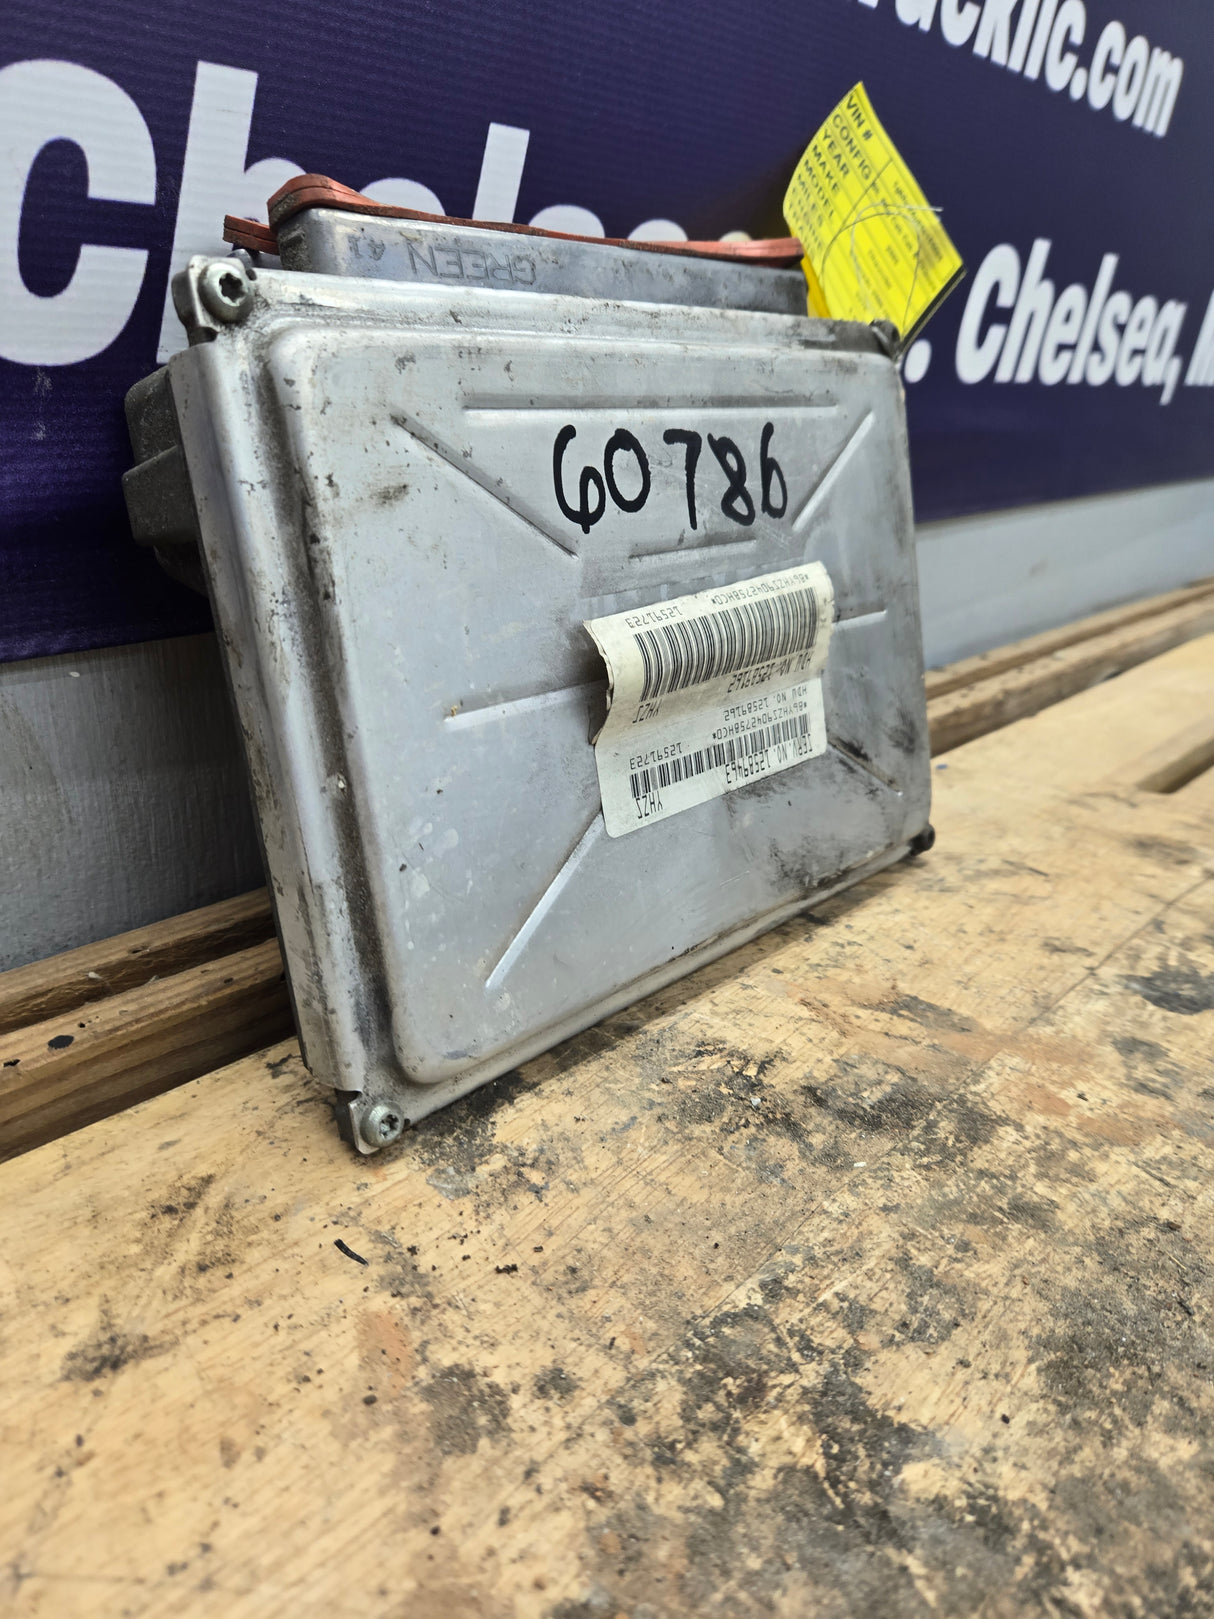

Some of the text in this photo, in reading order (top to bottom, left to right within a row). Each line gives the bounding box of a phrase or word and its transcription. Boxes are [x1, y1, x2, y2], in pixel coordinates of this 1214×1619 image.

[846, 95, 865, 128] VIN
[811, 144, 840, 193] MAKE
[823, 129, 850, 178] YEAR
[832, 113, 872, 180] CONFIG
[803, 159, 834, 218] MODEL
[407, 243, 537, 285] GREEN
[955, 237, 1188, 405] Chelsea,
[553, 421, 788, 534] 60786
[624, 605, 681, 629] 12591723
[723, 685, 808, 722] HDW NO. 12589162
[629, 742, 682, 770] 12591723
[725, 749, 771, 784] 12589463
